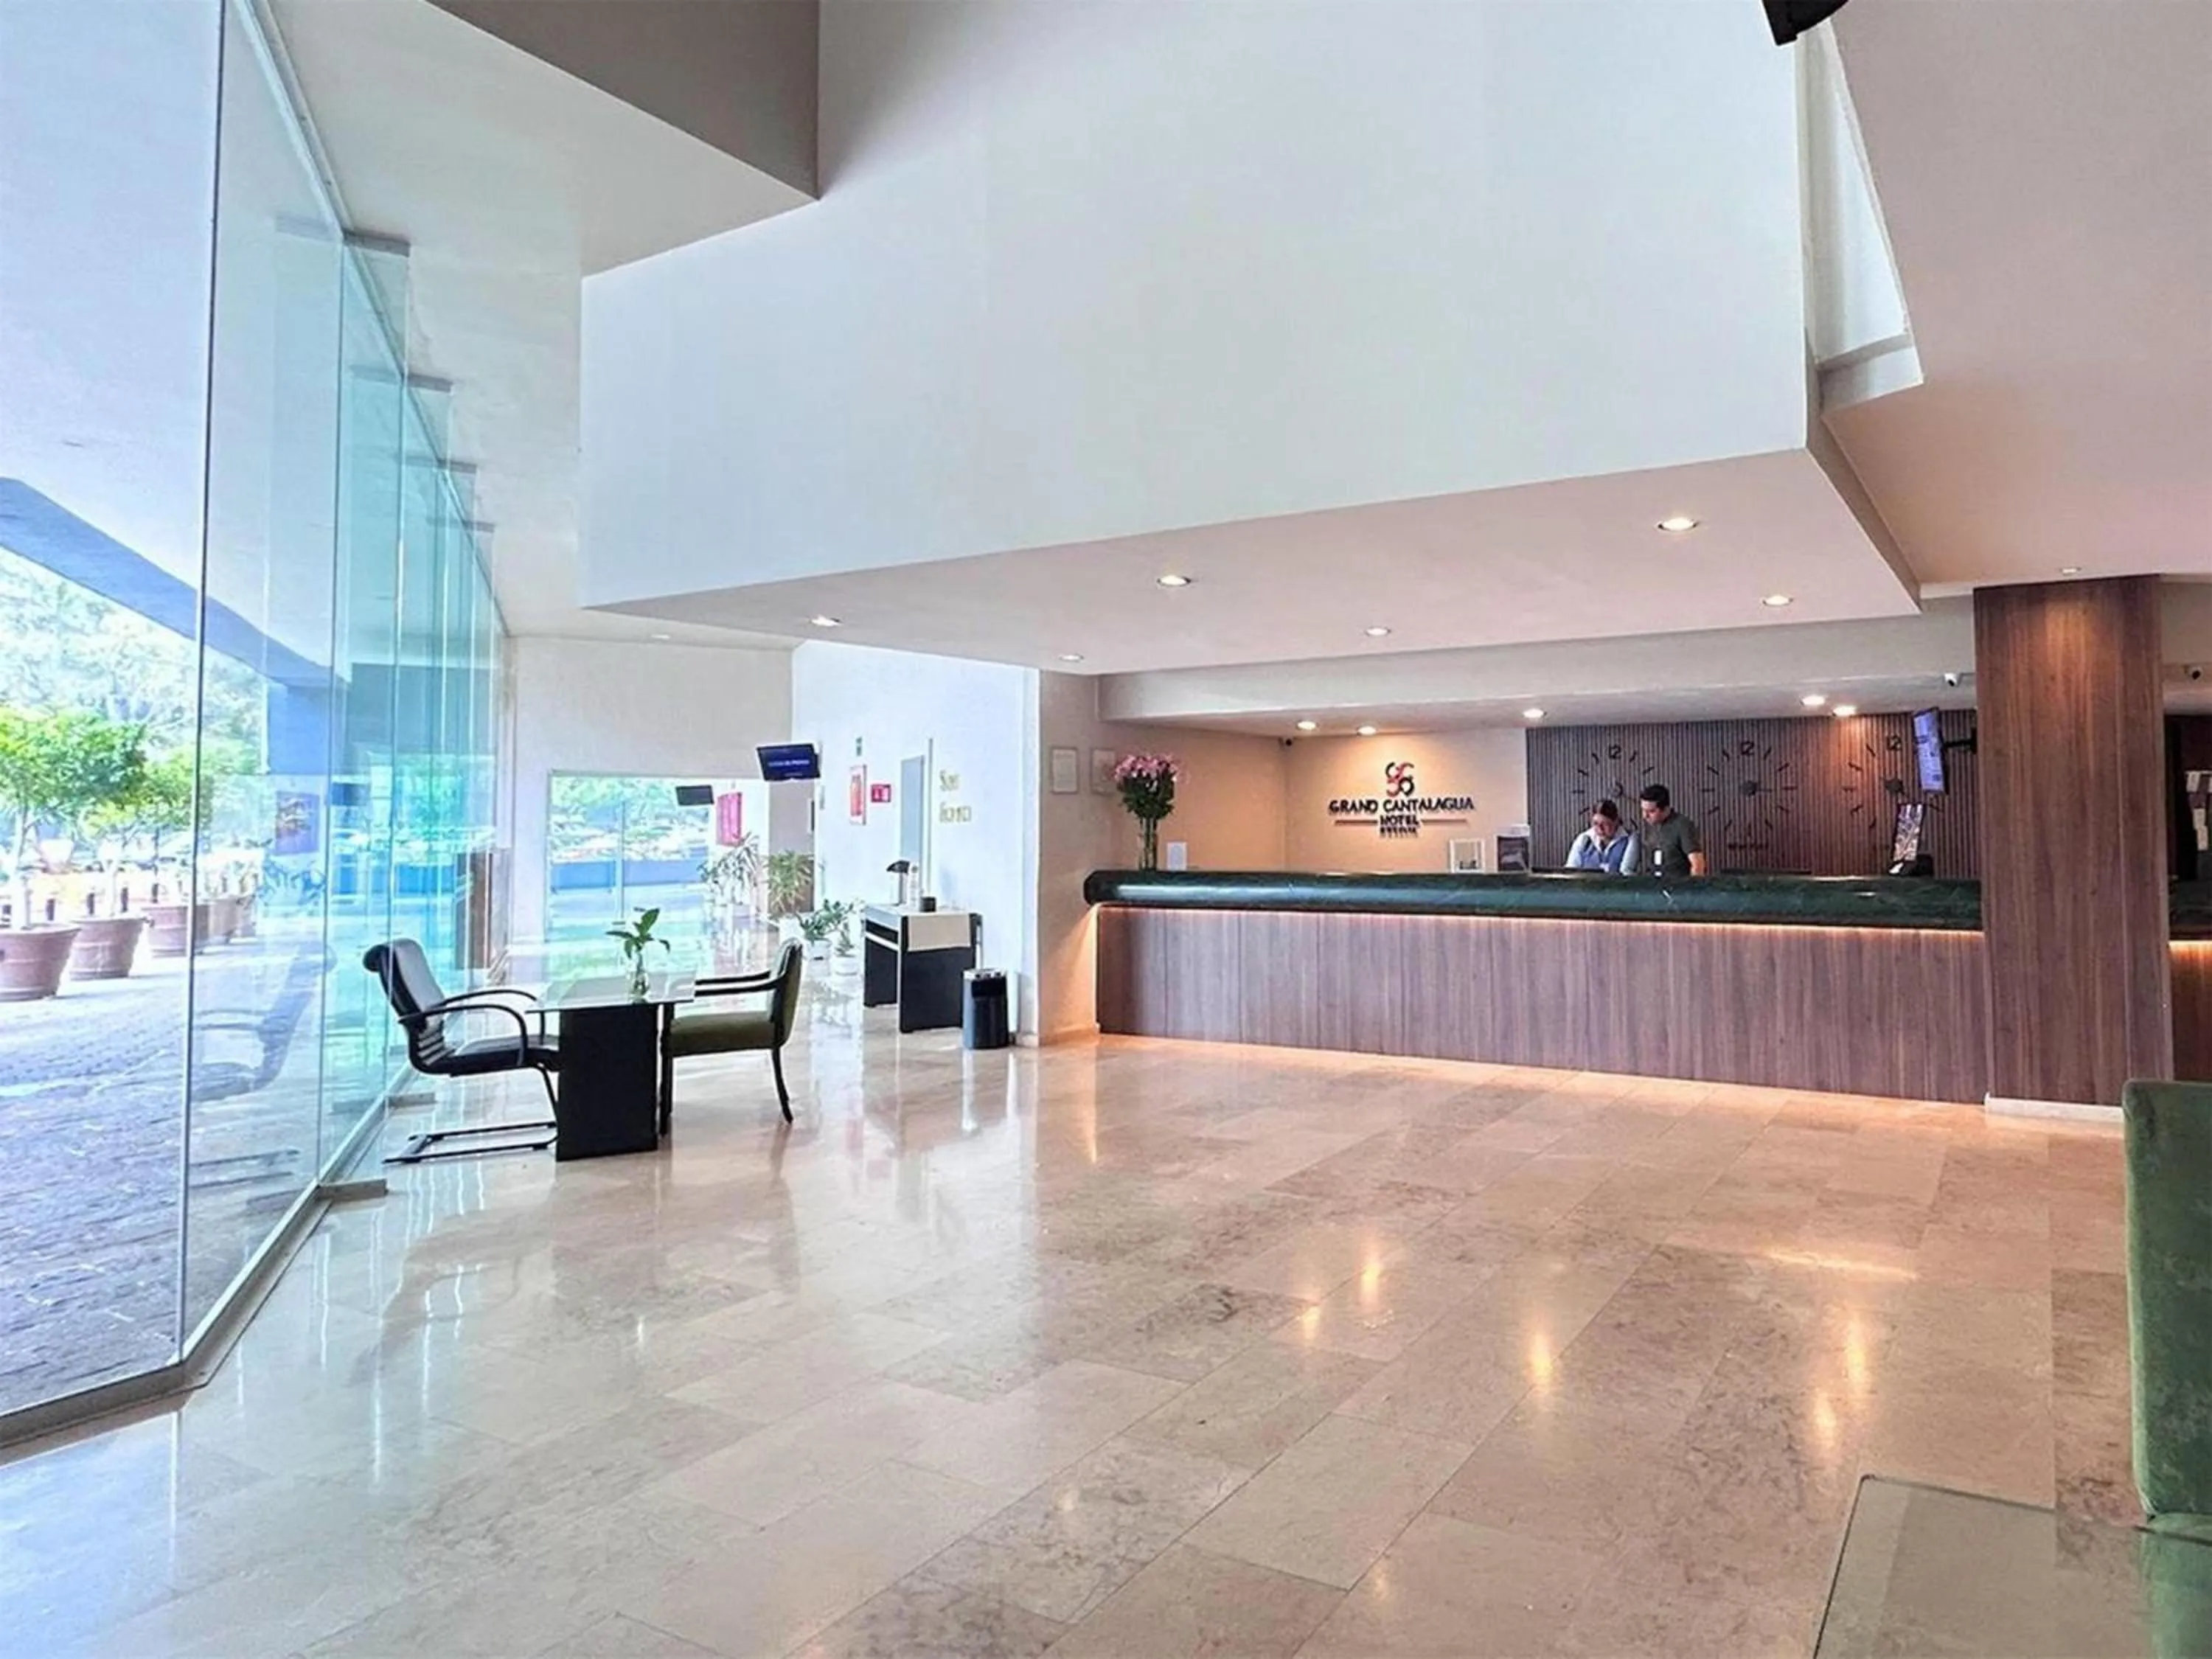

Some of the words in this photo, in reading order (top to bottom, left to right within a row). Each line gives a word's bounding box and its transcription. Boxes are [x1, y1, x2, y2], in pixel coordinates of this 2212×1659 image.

[1608, 744, 1621, 759] 12
[1741, 740, 1755, 757] 12
[1329, 799, 1378, 813] GRAND
[1383, 796, 1475, 813] CANTALAGUA
[1380, 814, 1419, 826] HOTEL
